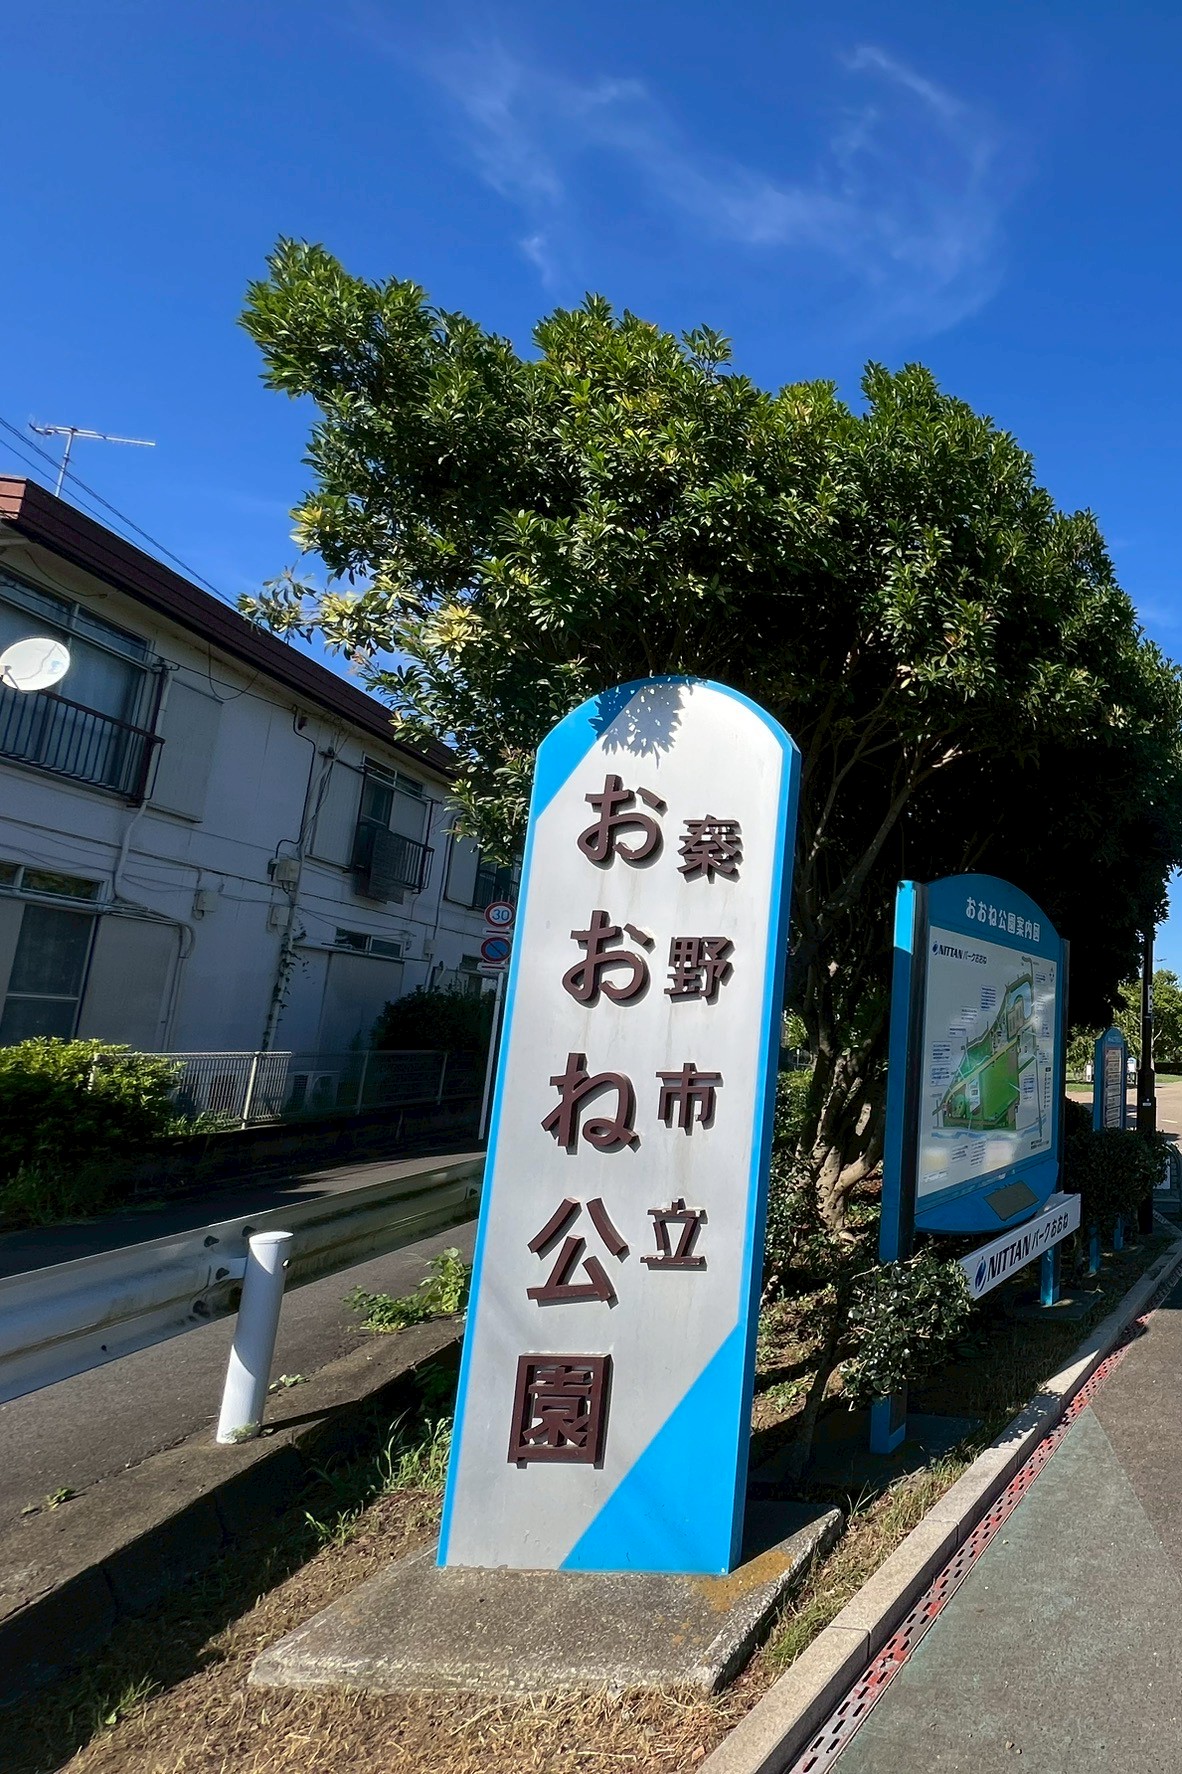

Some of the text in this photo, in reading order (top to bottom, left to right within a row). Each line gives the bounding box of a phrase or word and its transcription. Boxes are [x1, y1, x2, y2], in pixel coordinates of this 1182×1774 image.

[491, 908, 510, 921] 30
[966, 896, 1041, 943] おおね公園案内図
[640, 814, 744, 1270] 秦野市立
[508, 773, 667, 1470] おおね公園
[987, 1233, 1032, 1283] NITTAN
